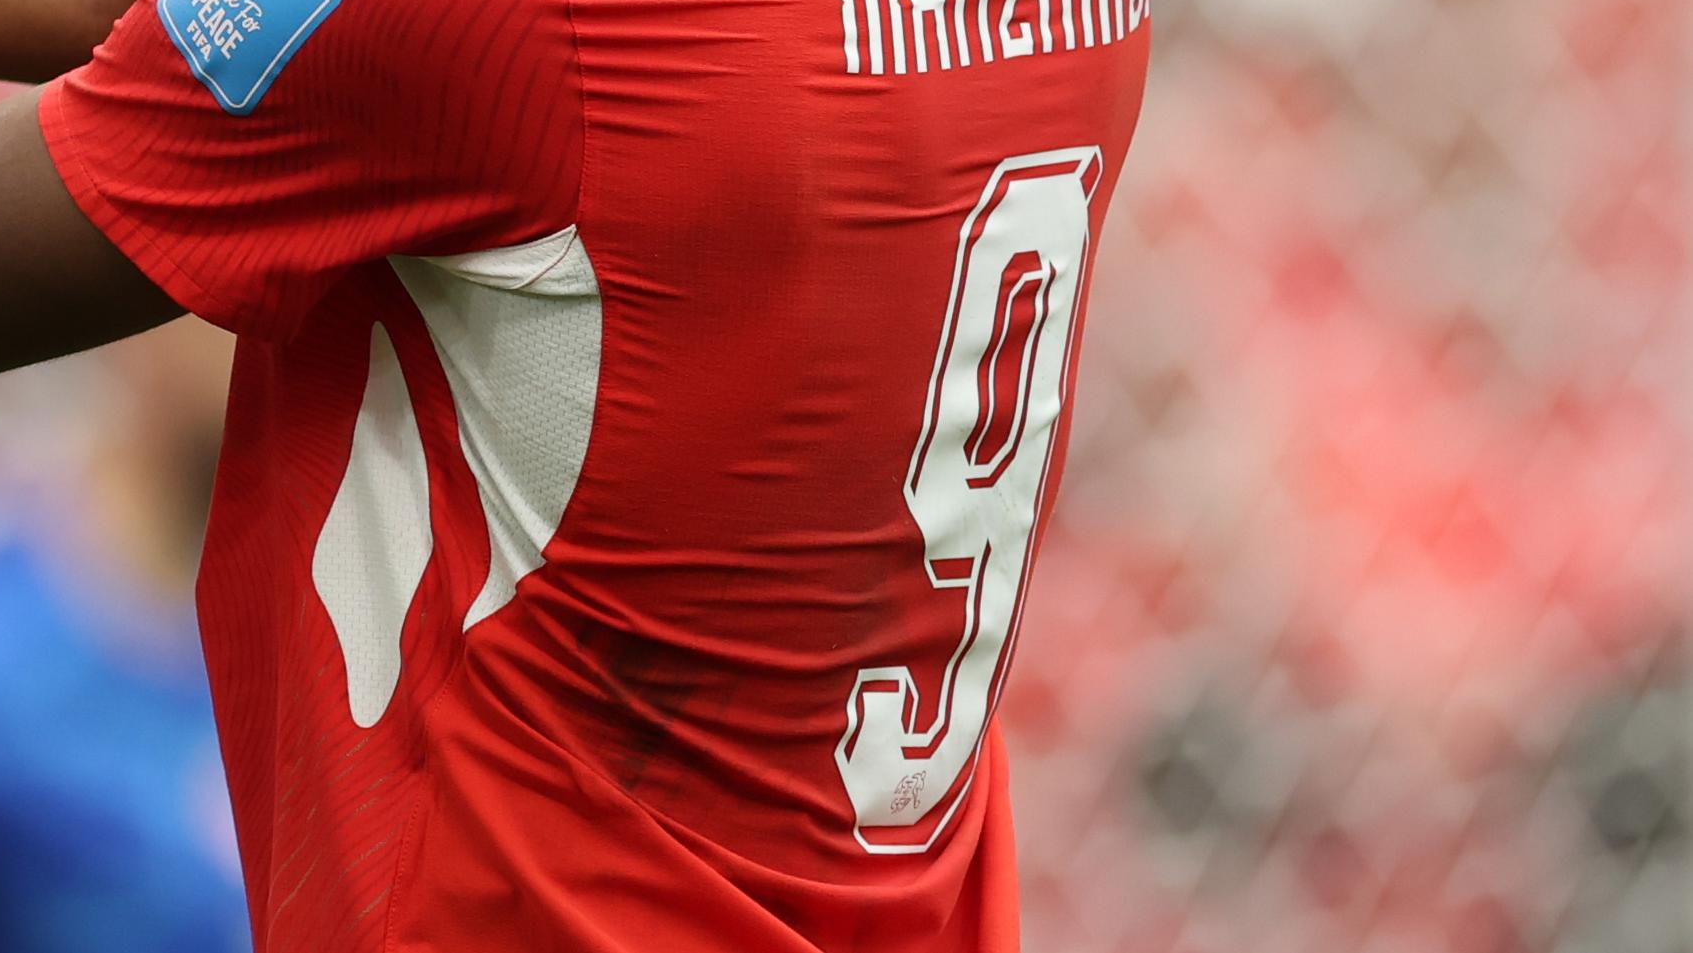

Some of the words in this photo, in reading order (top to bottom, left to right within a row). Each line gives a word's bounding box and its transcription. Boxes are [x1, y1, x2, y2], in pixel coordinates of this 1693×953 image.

[234, 0, 263, 33] For
[186, 19, 212, 63] FIFA
[835, 145, 1103, 854] 9
